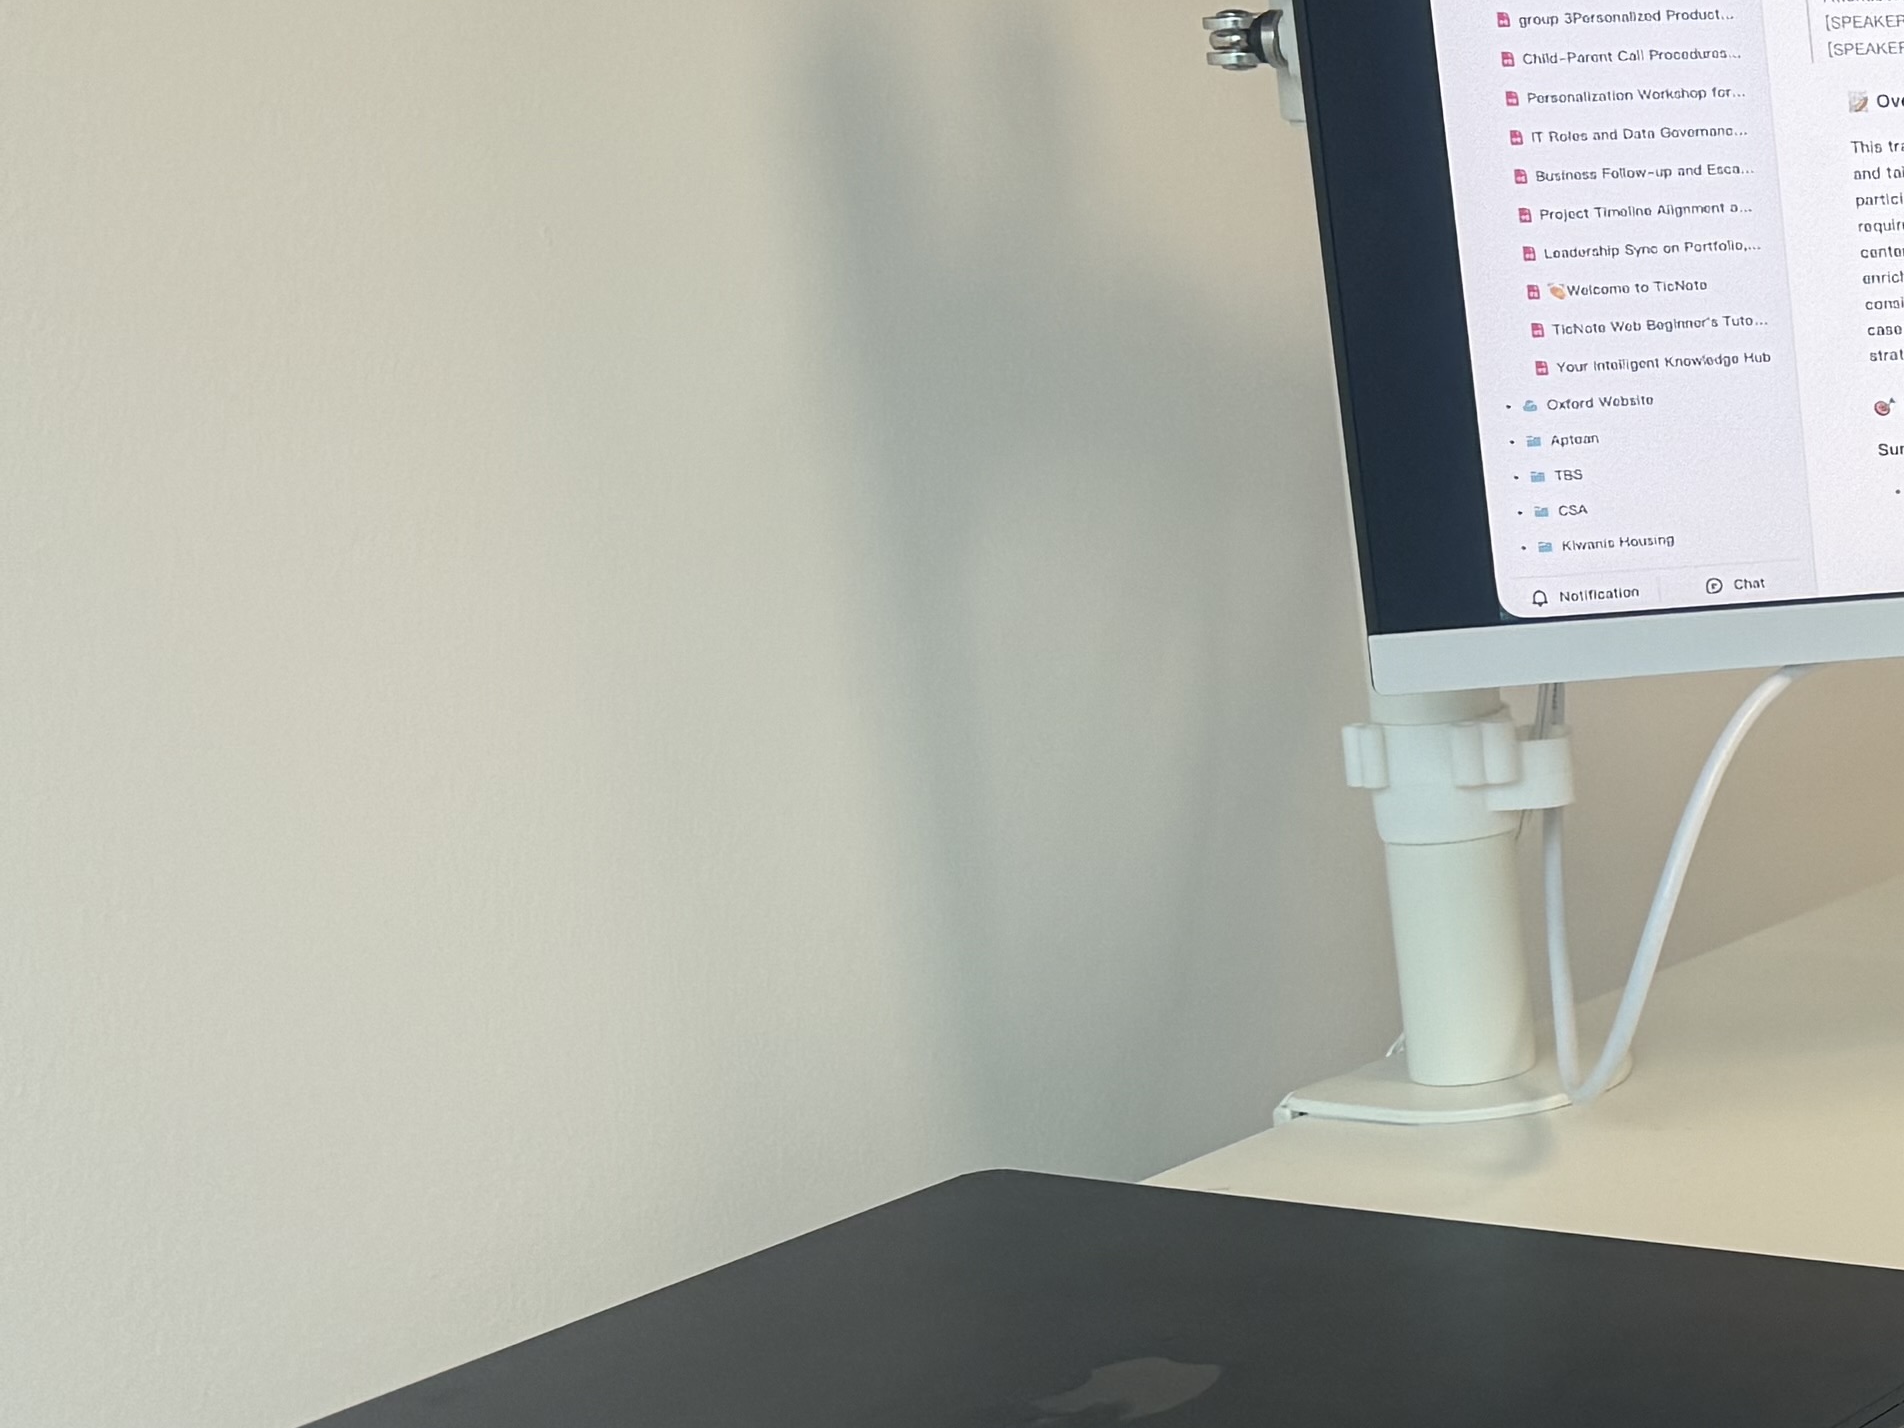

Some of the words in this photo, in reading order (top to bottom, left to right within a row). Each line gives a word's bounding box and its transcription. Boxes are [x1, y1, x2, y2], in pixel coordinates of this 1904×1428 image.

[1546, 397, 1594, 411] Oxford
[1598, 395, 1654, 407] Website
[1558, 504, 1589, 517] CSA
[1619, 535, 1675, 548] Housing
[1733, 578, 1765, 590] Chat
[1559, 588, 1640, 602] Notification
